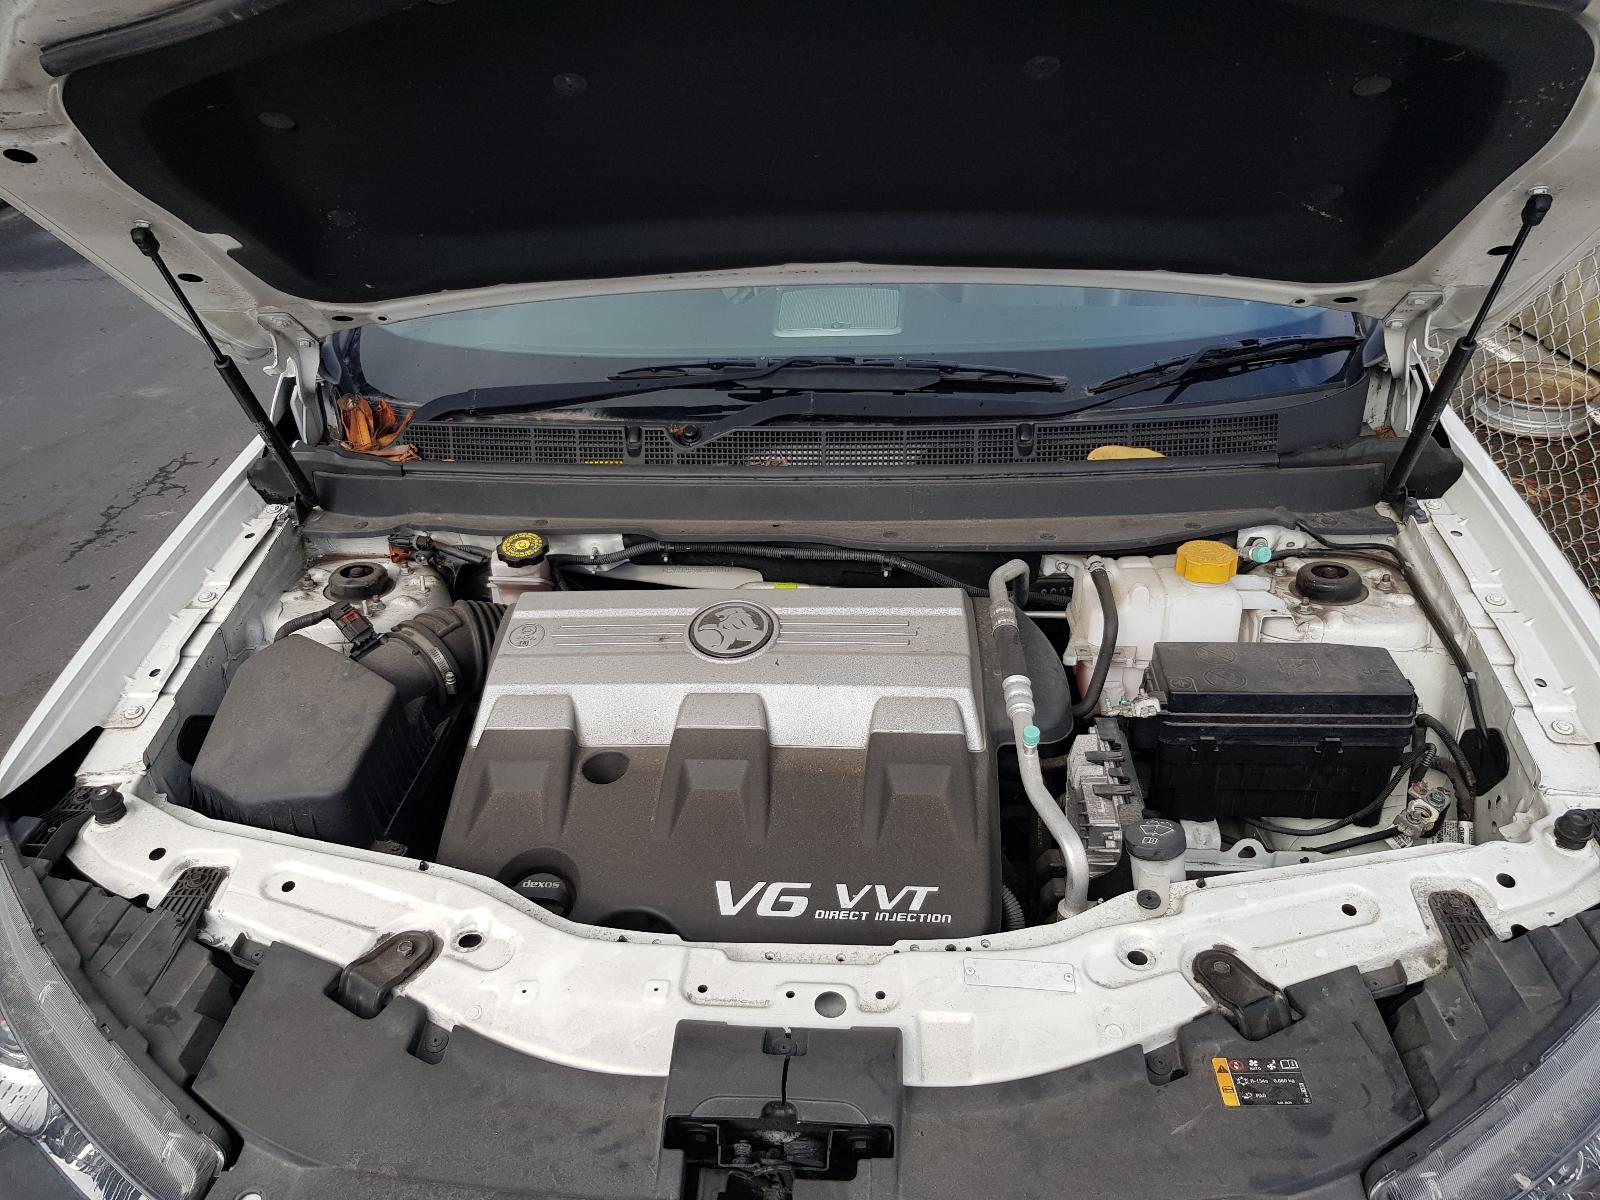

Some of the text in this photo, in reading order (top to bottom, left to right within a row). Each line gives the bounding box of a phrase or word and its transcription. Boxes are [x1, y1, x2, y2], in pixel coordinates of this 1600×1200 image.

[522, 879, 561, 889] dexos
[715, 880, 940, 918] V6 VVT
[814, 909, 952, 924] DIRECT INJECTION
